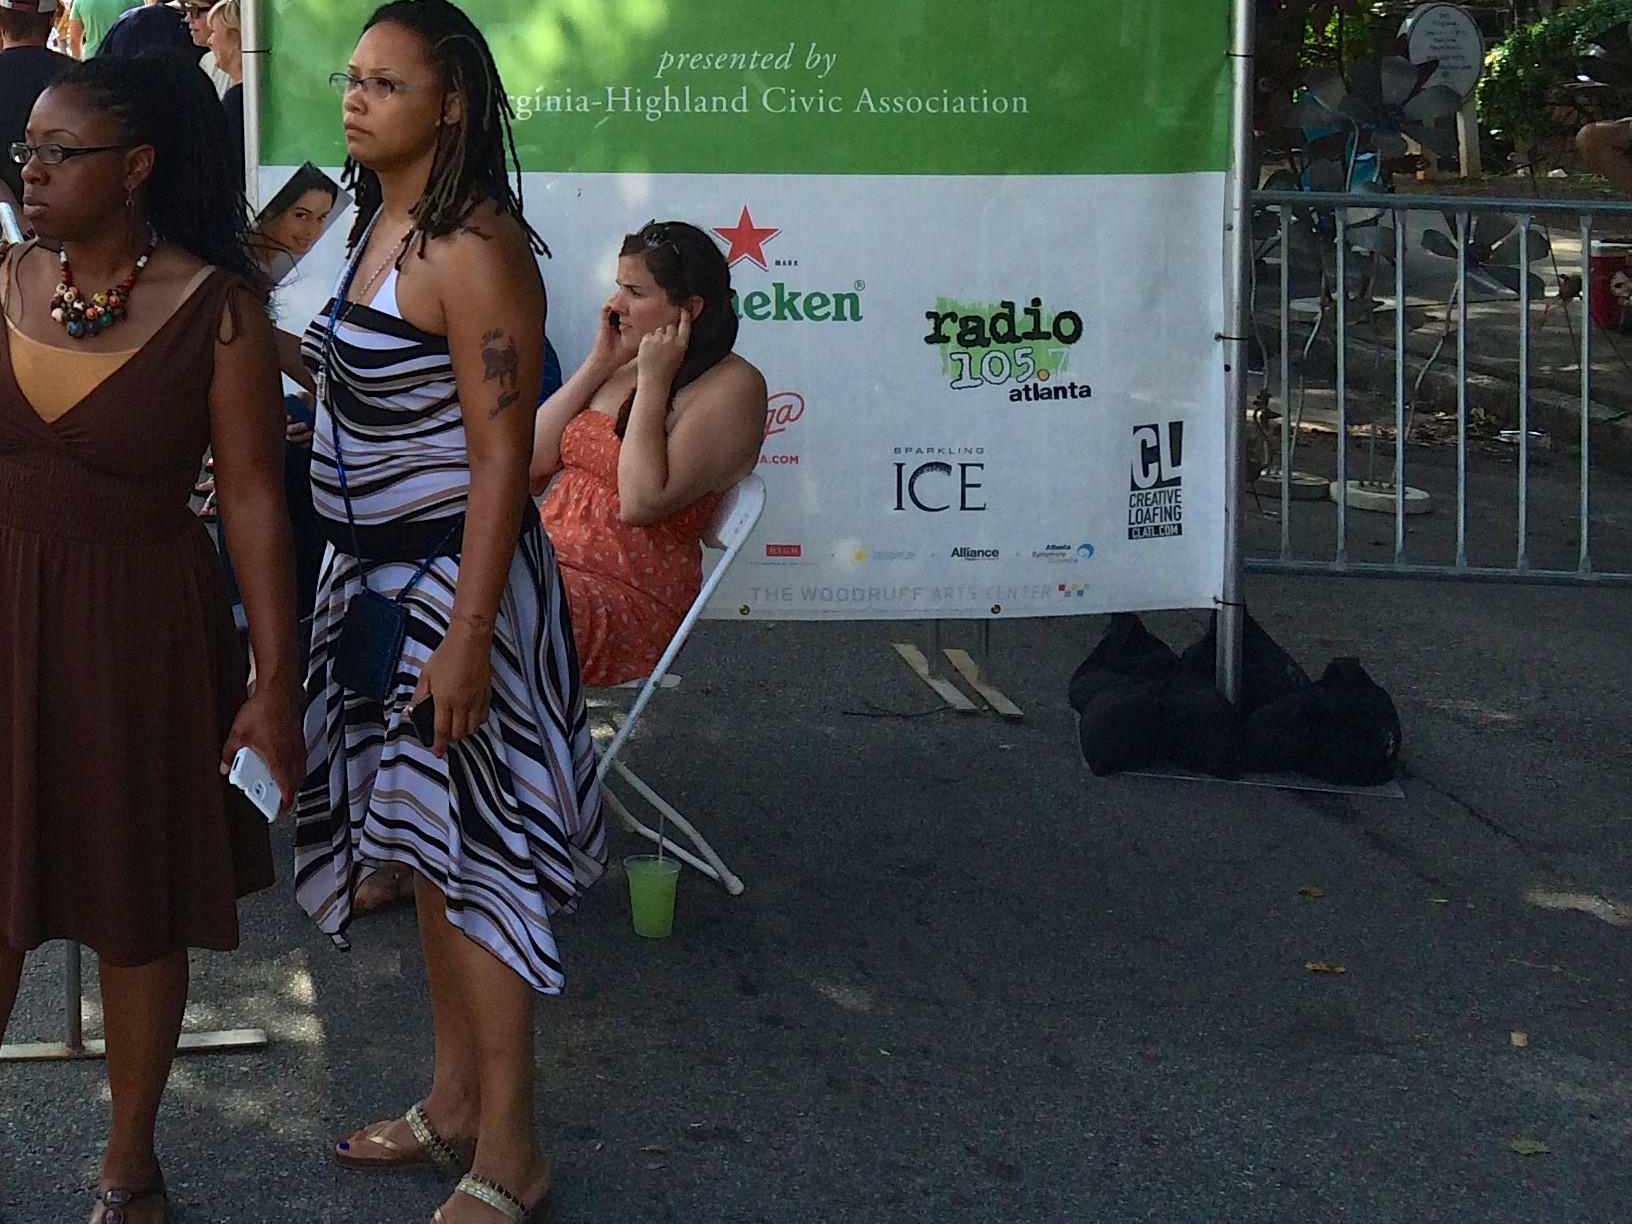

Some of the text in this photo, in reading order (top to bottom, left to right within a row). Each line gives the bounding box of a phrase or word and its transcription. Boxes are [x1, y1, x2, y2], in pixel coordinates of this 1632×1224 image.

[654, 42, 837, 79] presented by
[505, 86, 1030, 122] rginia-Highland Civic Association
[731, 282, 864, 322] eken
[923, 297, 1084, 348] radio
[1009, 382, 1092, 402] atlanta
[757, 454, 799, 465] A.COM
[893, 446, 986, 455] SPARKLING
[893, 461, 987, 513] ICE
[1129, 488, 1183, 509] CREATIVE
[1128, 504, 1183, 526] LOAFING
[950, 546, 1000, 558] Alliance
[749, 586, 793, 602] THE
[800, 586, 925, 602] WOODRUFF
